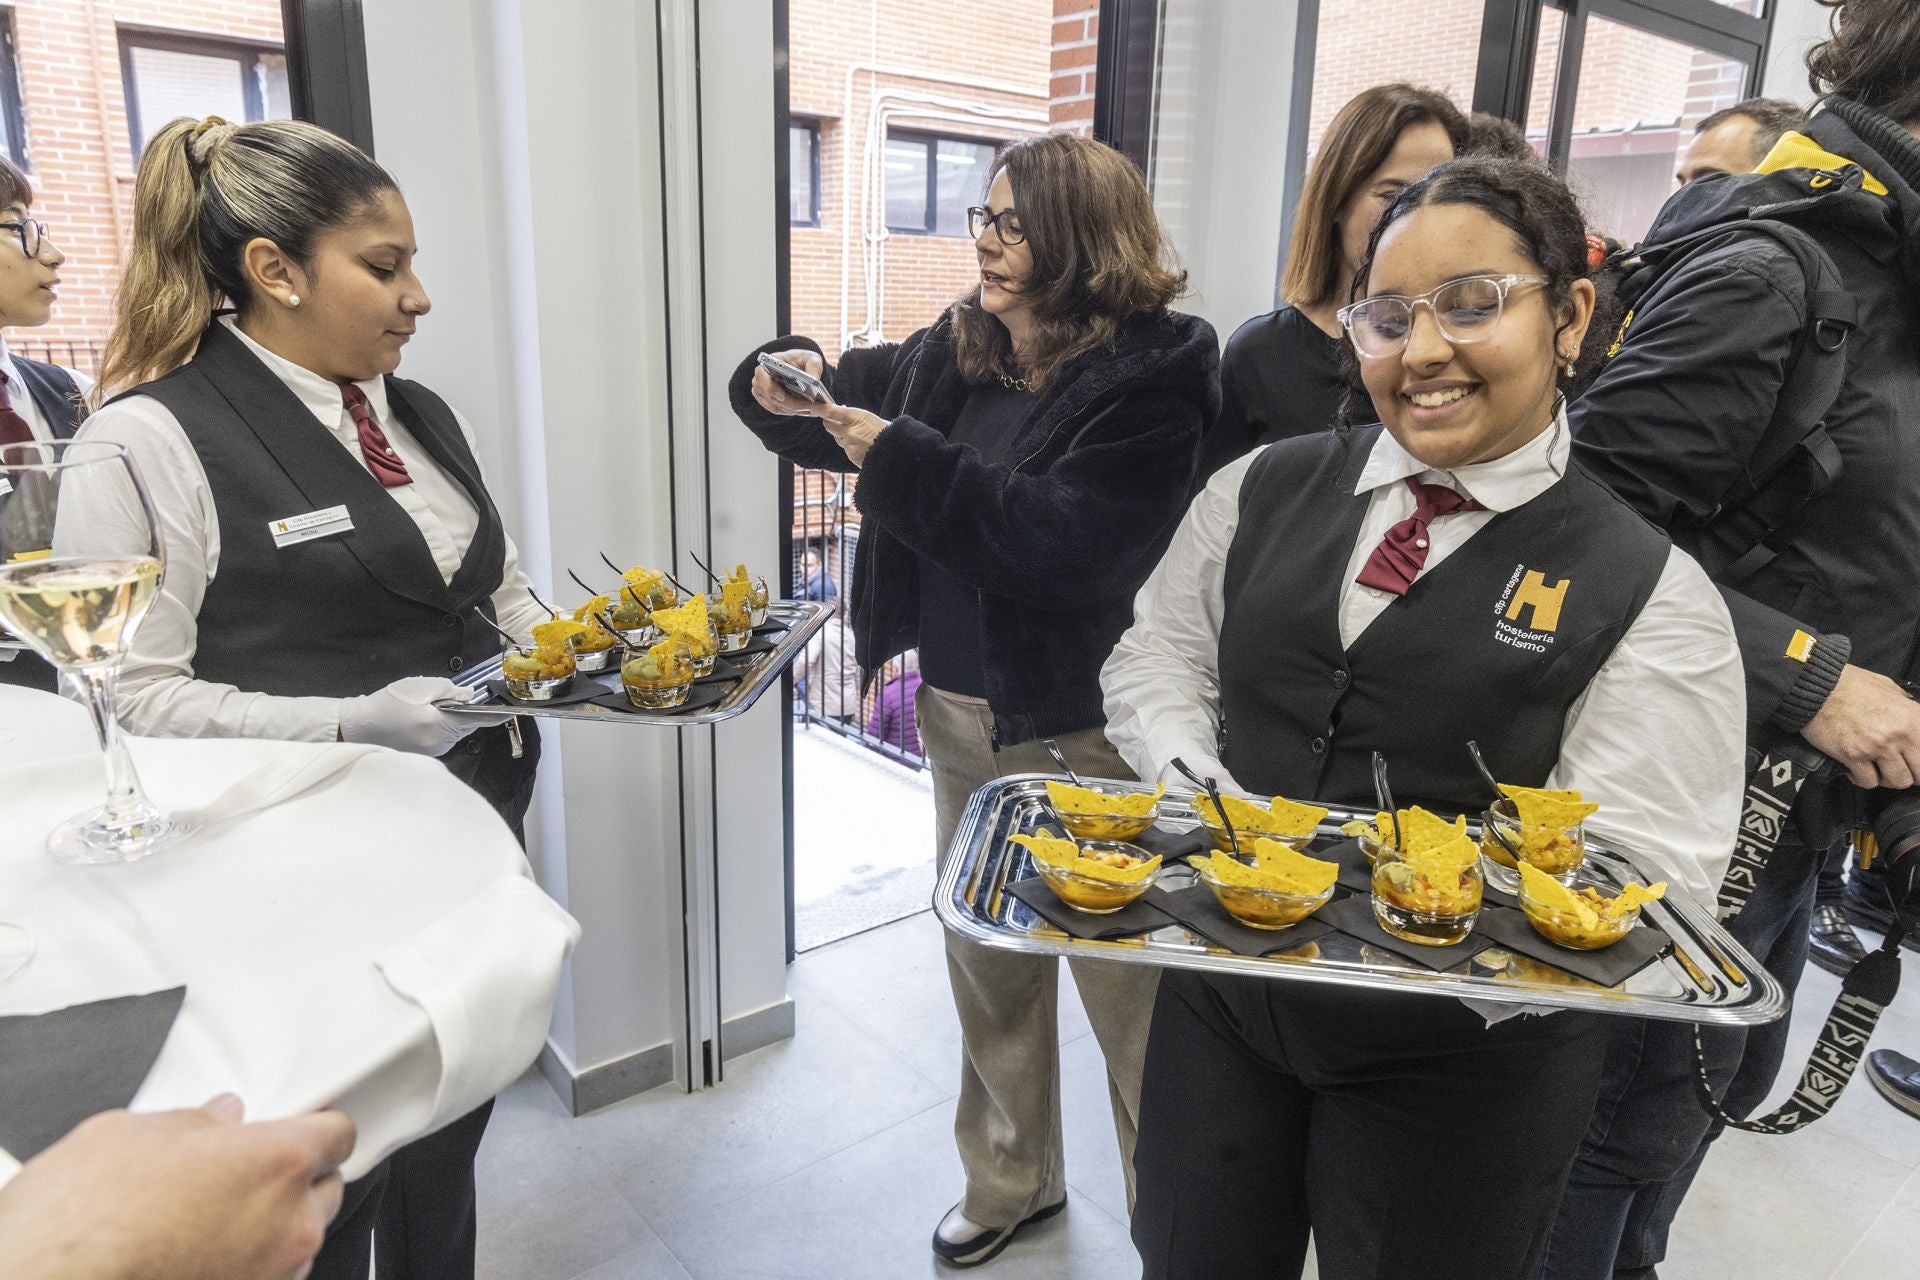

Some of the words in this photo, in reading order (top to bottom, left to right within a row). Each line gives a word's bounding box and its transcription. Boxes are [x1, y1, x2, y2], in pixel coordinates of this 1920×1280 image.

[1501, 563, 1525, 600] cartagena
[1494, 630, 1546, 653] turismo
[1496, 619, 1554, 644] hostelería
